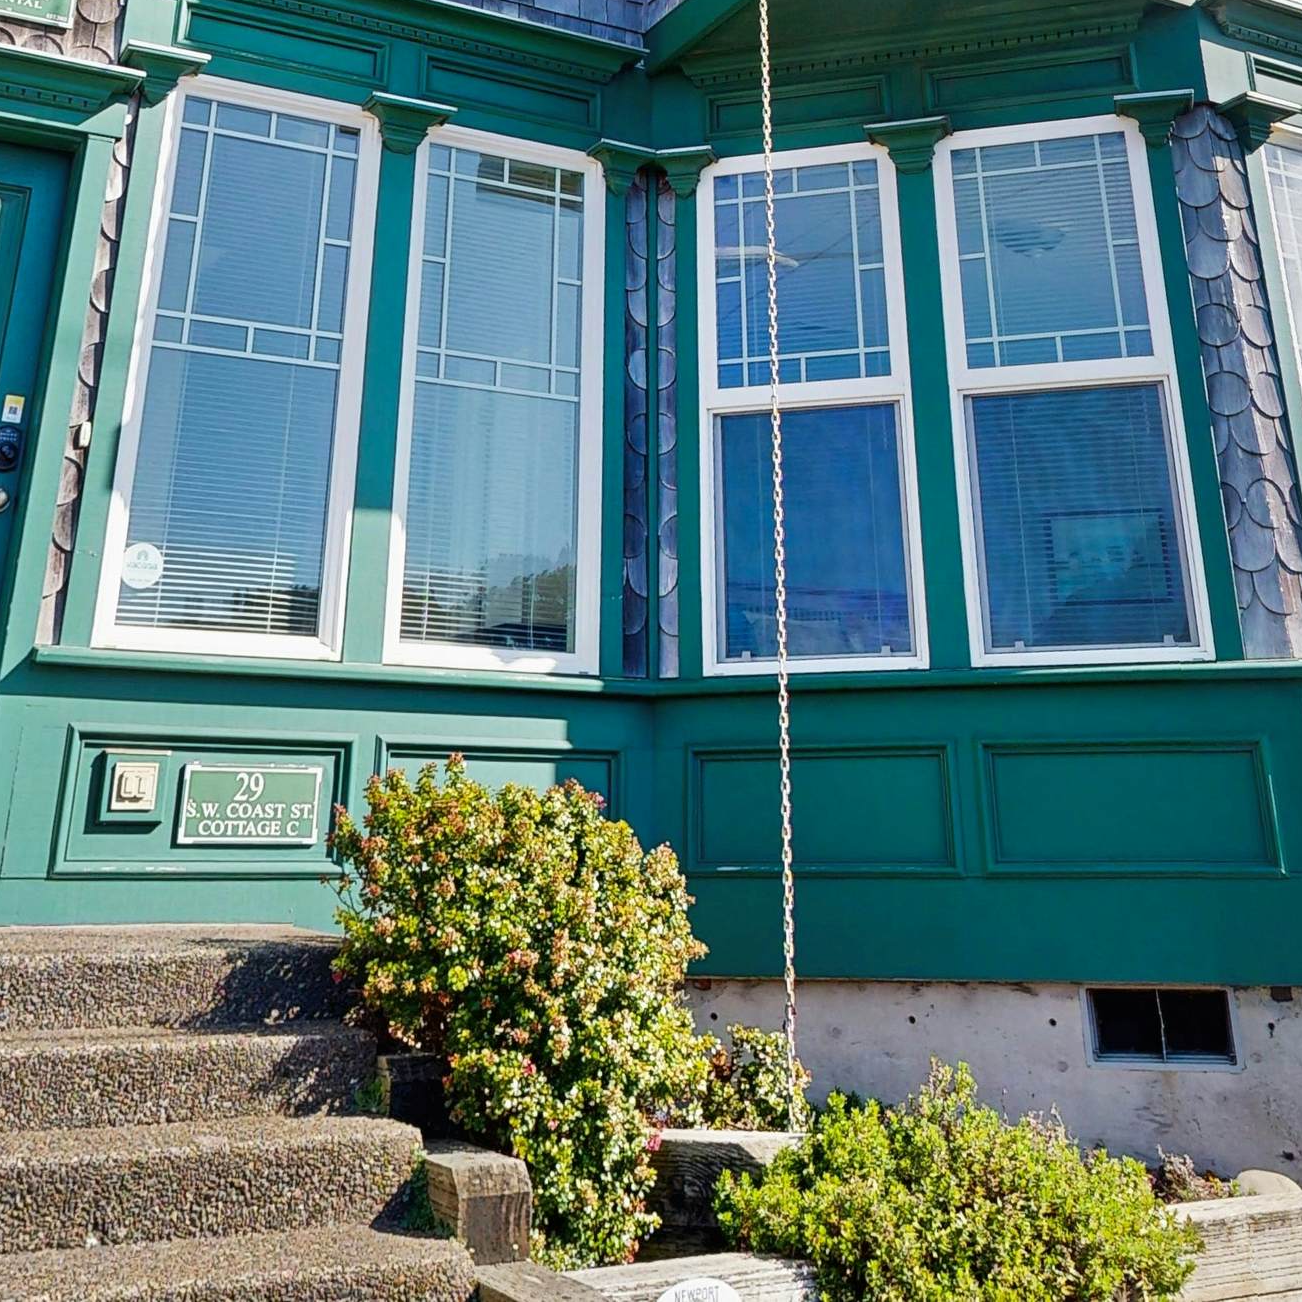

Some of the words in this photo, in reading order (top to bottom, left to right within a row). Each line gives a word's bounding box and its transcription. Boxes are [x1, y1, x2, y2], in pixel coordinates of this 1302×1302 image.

[233, 772, 265, 801] 29
[186, 802, 220, 819] S.W.
[226, 802, 286, 819] COAST
[291, 802, 314, 819] ST.
[198, 820, 281, 836] COTTAGE
[286, 820, 299, 836] C
[674, 1285, 719, 1302] NEWPORT
